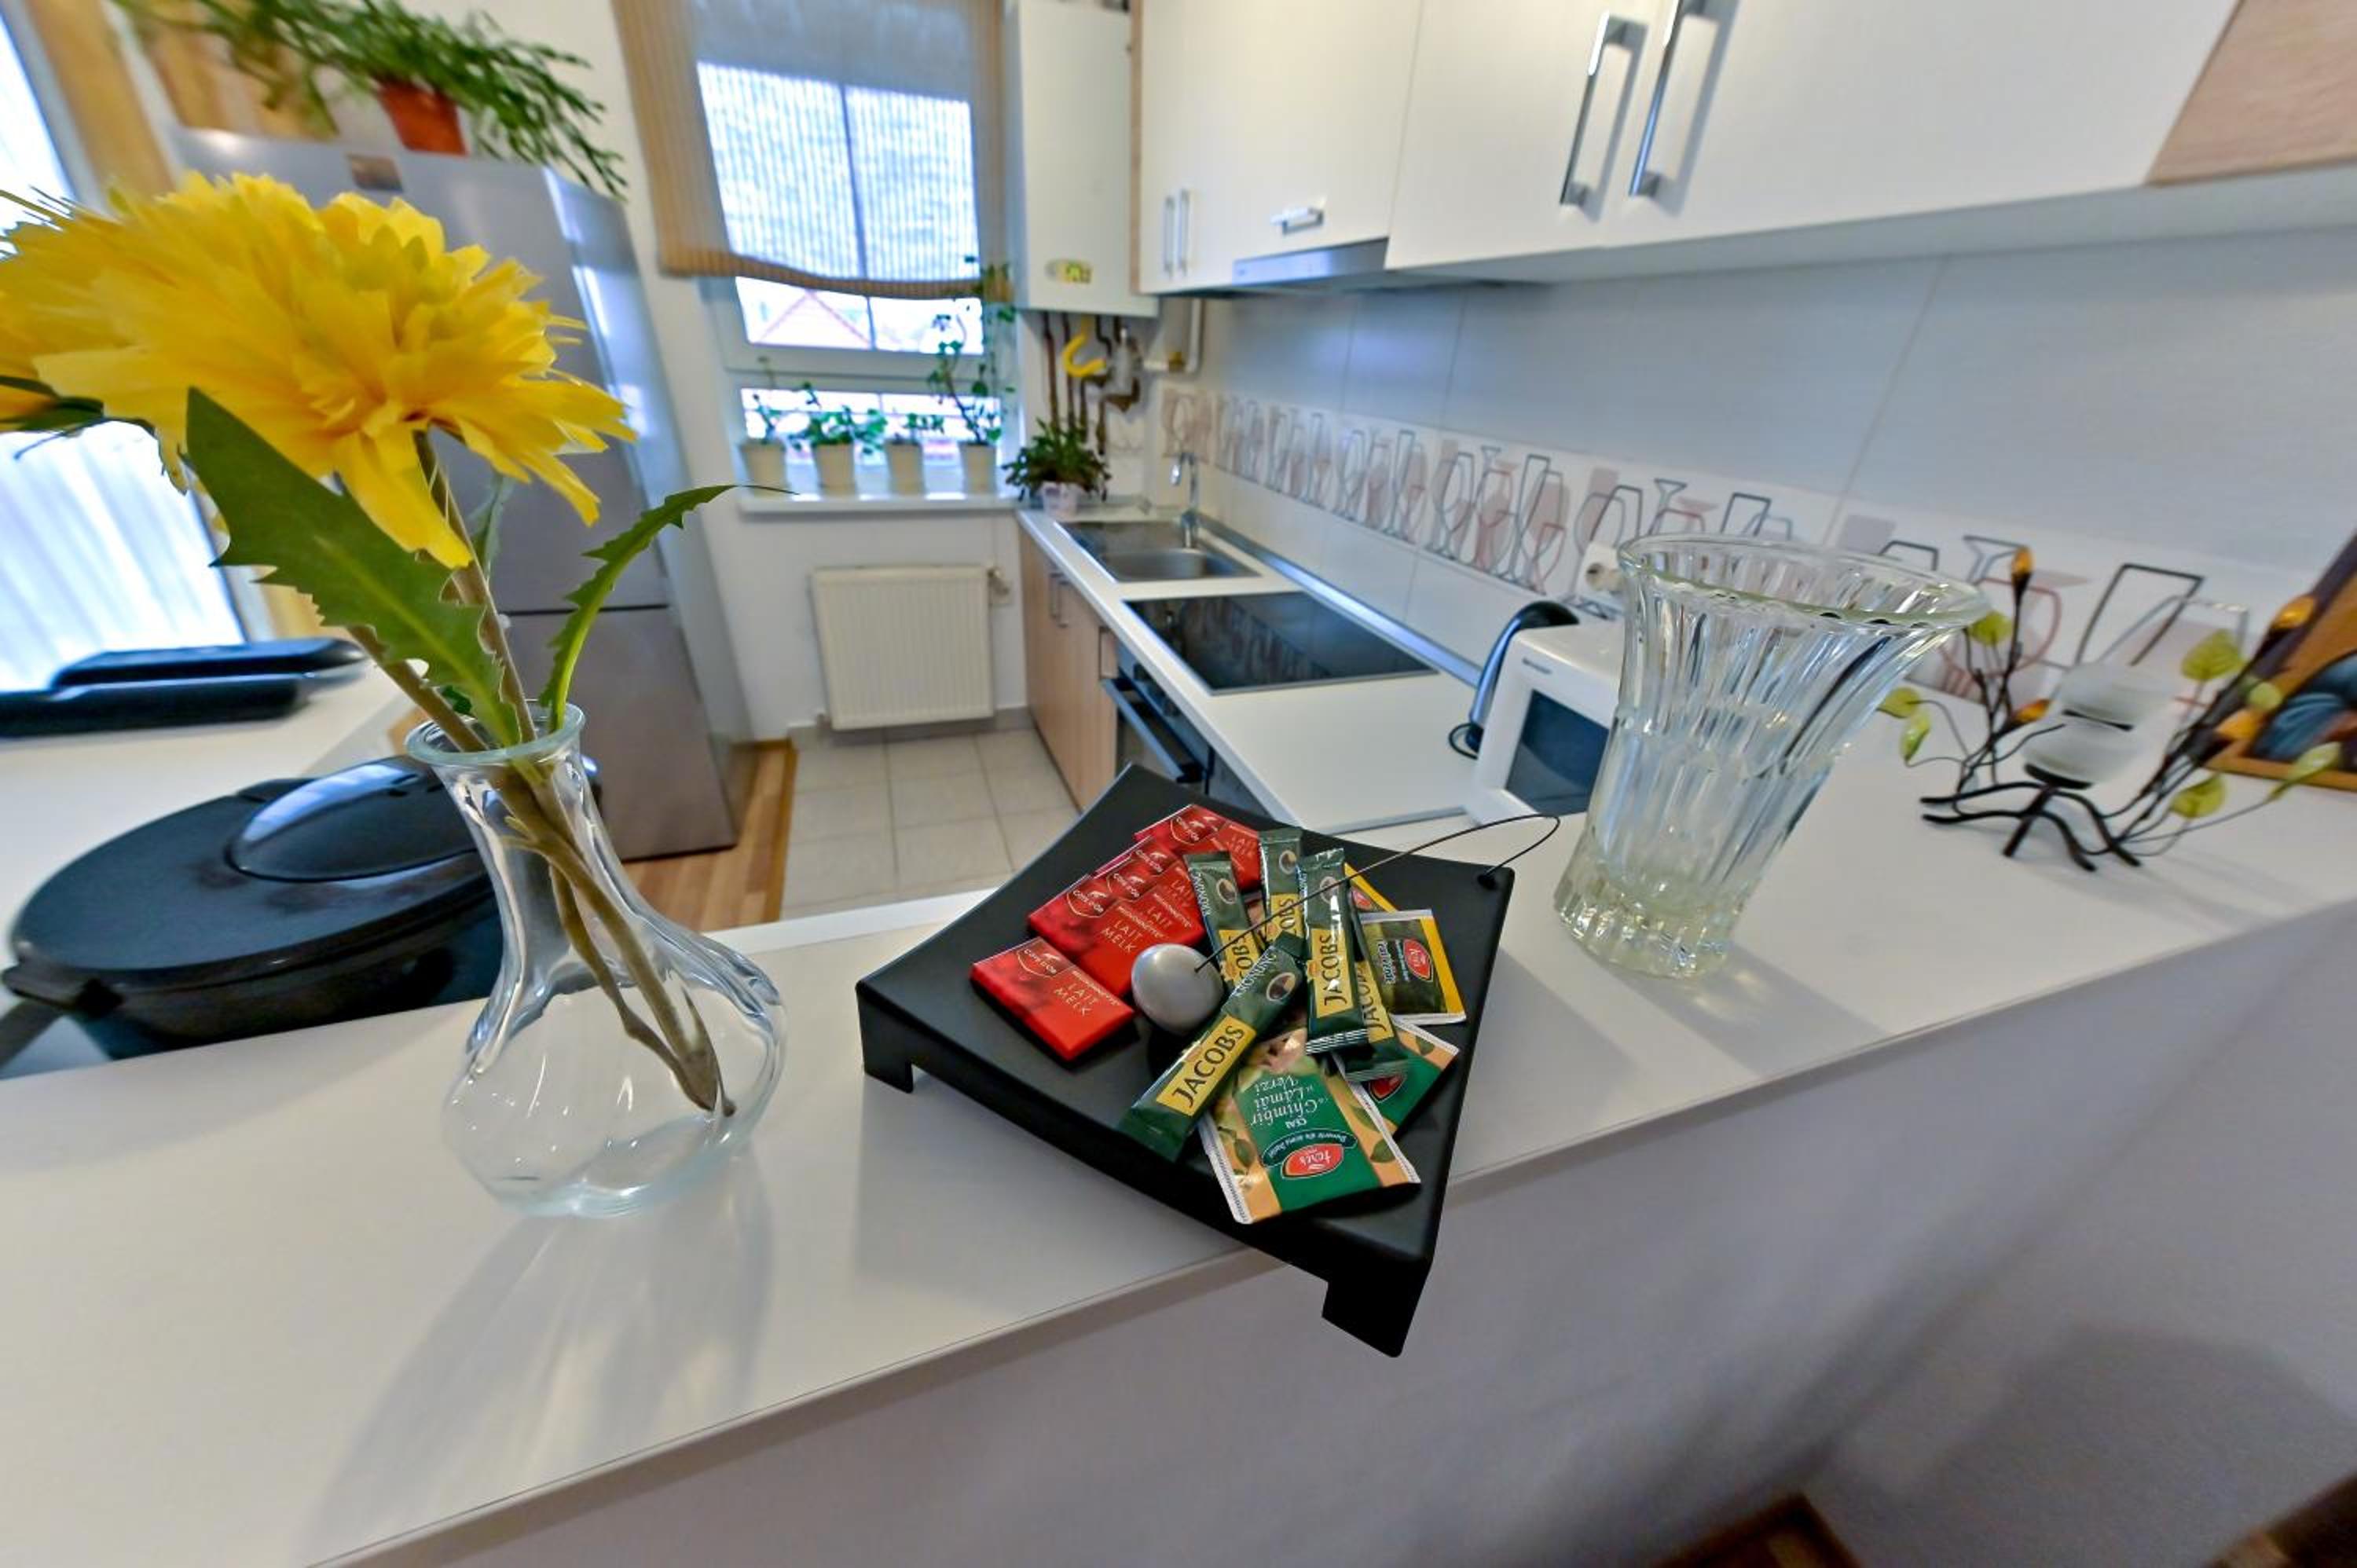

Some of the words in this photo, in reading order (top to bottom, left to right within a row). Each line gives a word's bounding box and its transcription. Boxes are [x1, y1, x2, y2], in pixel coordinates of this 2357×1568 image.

[1101, 927, 1137, 953] MELK
[1114, 920, 1143, 941] LAIT
[1319, 933, 1348, 1006] JACOBS
[1054, 987, 1093, 1017] MELK
[1067, 983, 1098, 1005] LAIT
[1172, 1025, 1246, 1108] JACOBS
[1255, 1075, 1299, 1096] Verzi
[1250, 1099, 1318, 1127] Ghimbir
